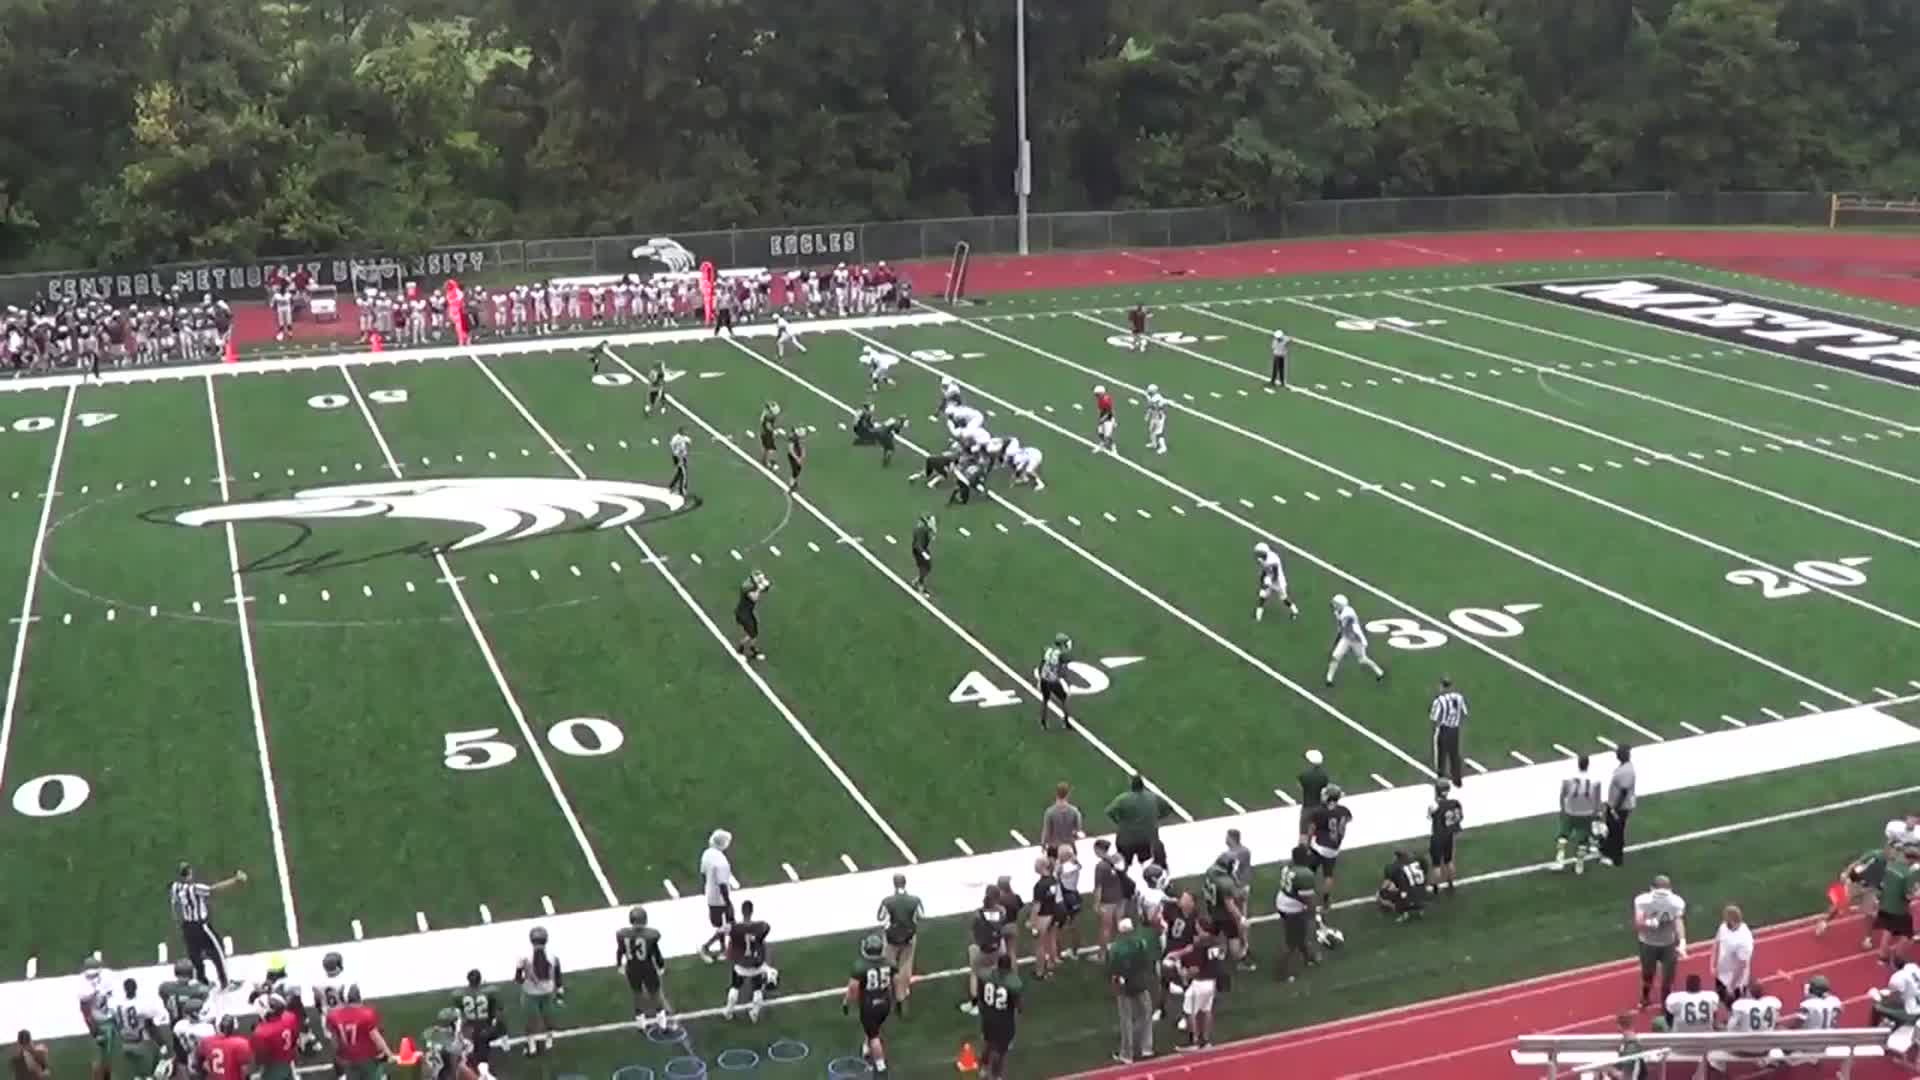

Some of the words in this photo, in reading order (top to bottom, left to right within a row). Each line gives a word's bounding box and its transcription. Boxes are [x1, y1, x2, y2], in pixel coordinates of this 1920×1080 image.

[770, 231, 855, 256] EAGLES
[1725, 560, 1868, 598] 20
[1365, 607, 1524, 650] 30
[444, 715, 624, 770] 50
[1403, 861, 1425, 887] 15
[623, 936, 648, 961] 13
[865, 966, 892, 990] 85
[462, 995, 489, 1021] 22
[983, 982, 1009, 1010] 82
[337, 1023, 358, 1046] 17
[211, 1047, 225, 1074] 2
